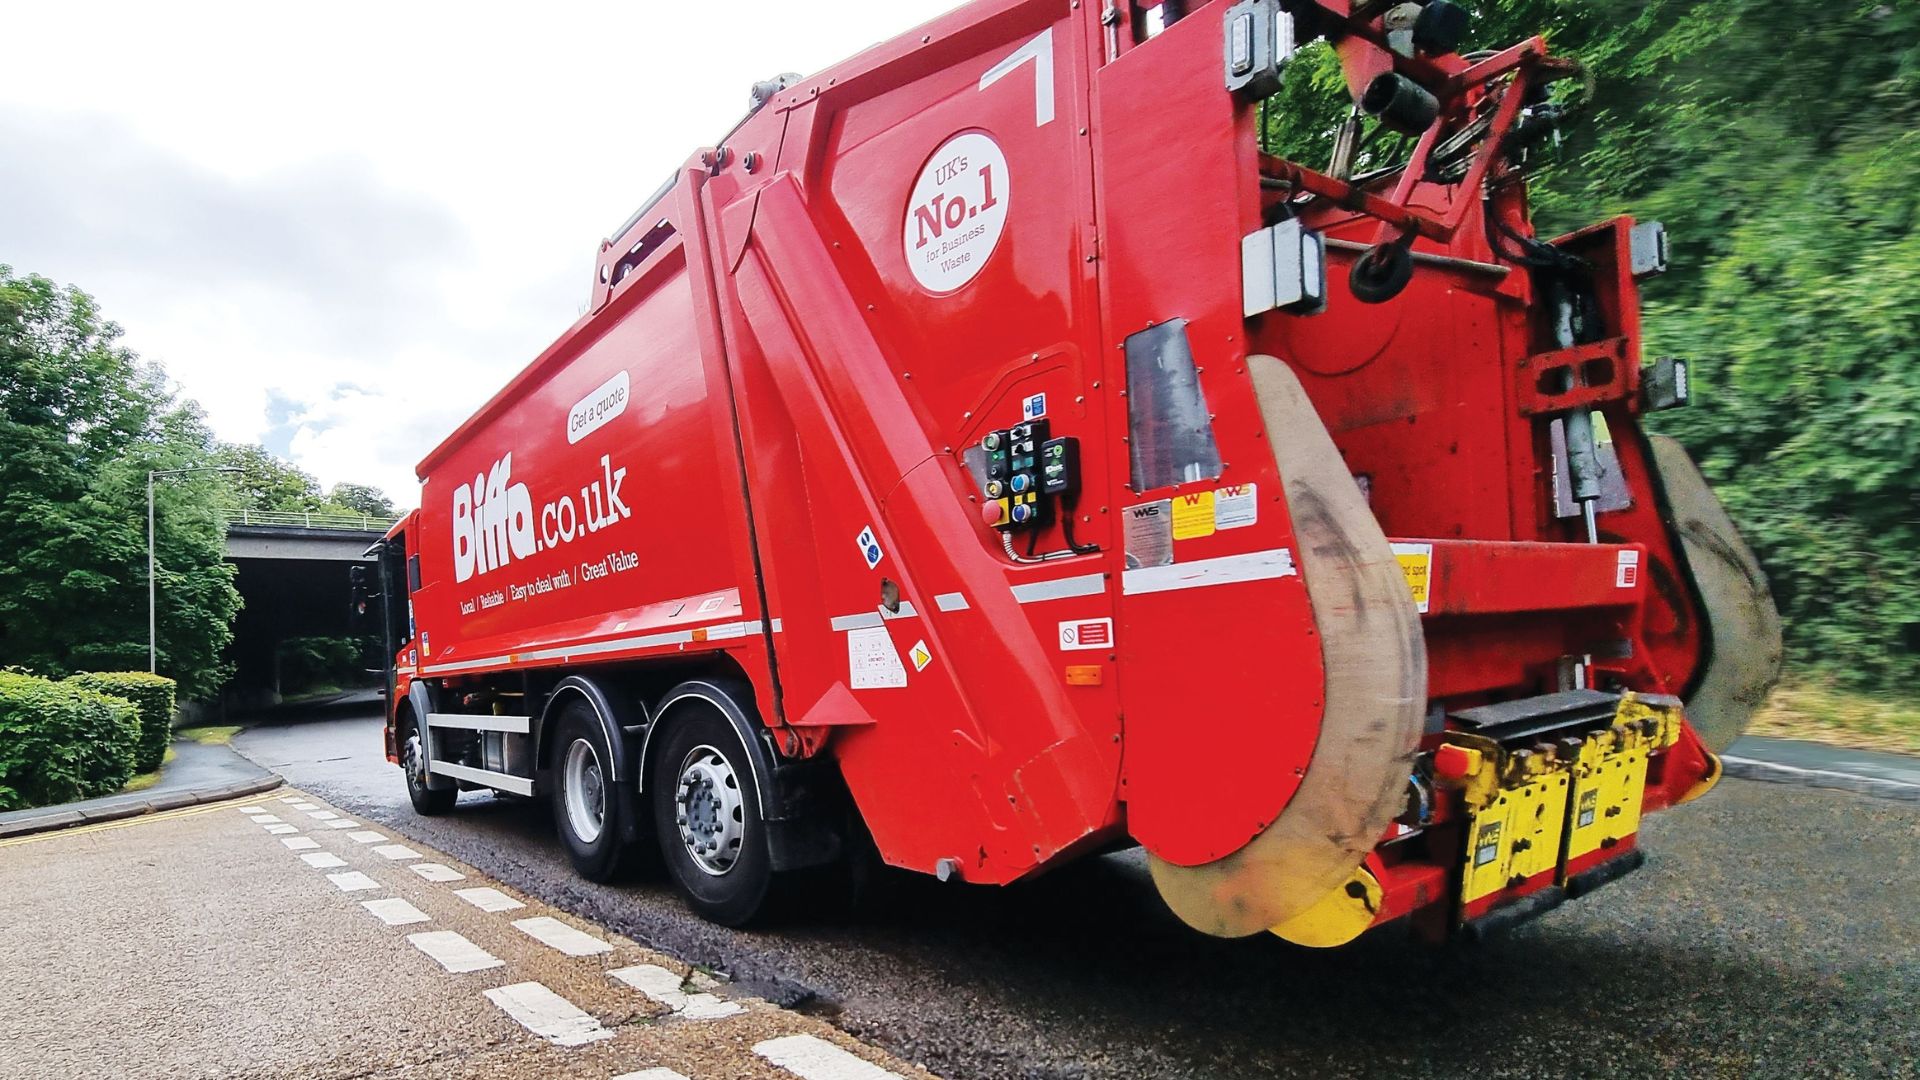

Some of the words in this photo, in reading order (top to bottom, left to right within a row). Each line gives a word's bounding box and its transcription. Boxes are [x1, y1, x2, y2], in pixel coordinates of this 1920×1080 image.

[936, 155, 968, 186] UK's
[914, 163, 997, 250] No.1
[926, 250, 940, 263] for
[942, 224, 985, 255] Business
[940, 251, 971, 273] Waste
[571, 409, 587, 433] Get
[589, 407, 595, 421] a
[596, 387, 625, 420] quote
[460, 598, 475, 615] Local
[480, 590, 505, 609] Reliable
[510, 584, 527, 602] Easy
[527, 582, 536, 596] to
[536, 574, 553, 594] deal
[552, 569, 571, 589] with
[581, 558, 608, 581] Great
[607, 550, 639, 573] Value
